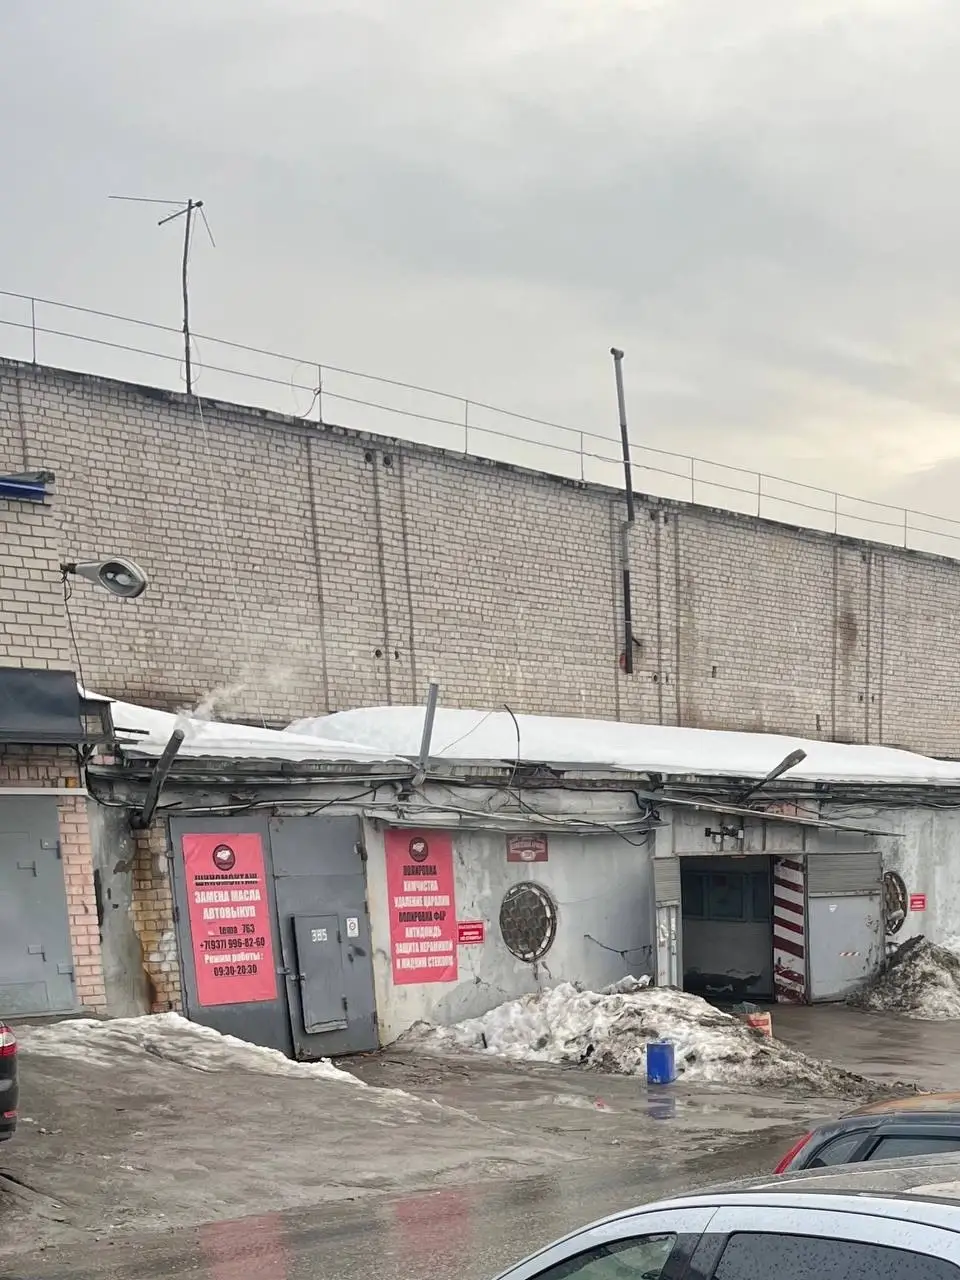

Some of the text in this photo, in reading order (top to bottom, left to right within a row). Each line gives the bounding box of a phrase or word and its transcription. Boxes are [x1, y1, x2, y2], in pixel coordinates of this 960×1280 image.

[194, 889, 261, 904] ЗАМЕНА МАСЛА
[203, 906, 256, 920] АВТОВЫКУП
